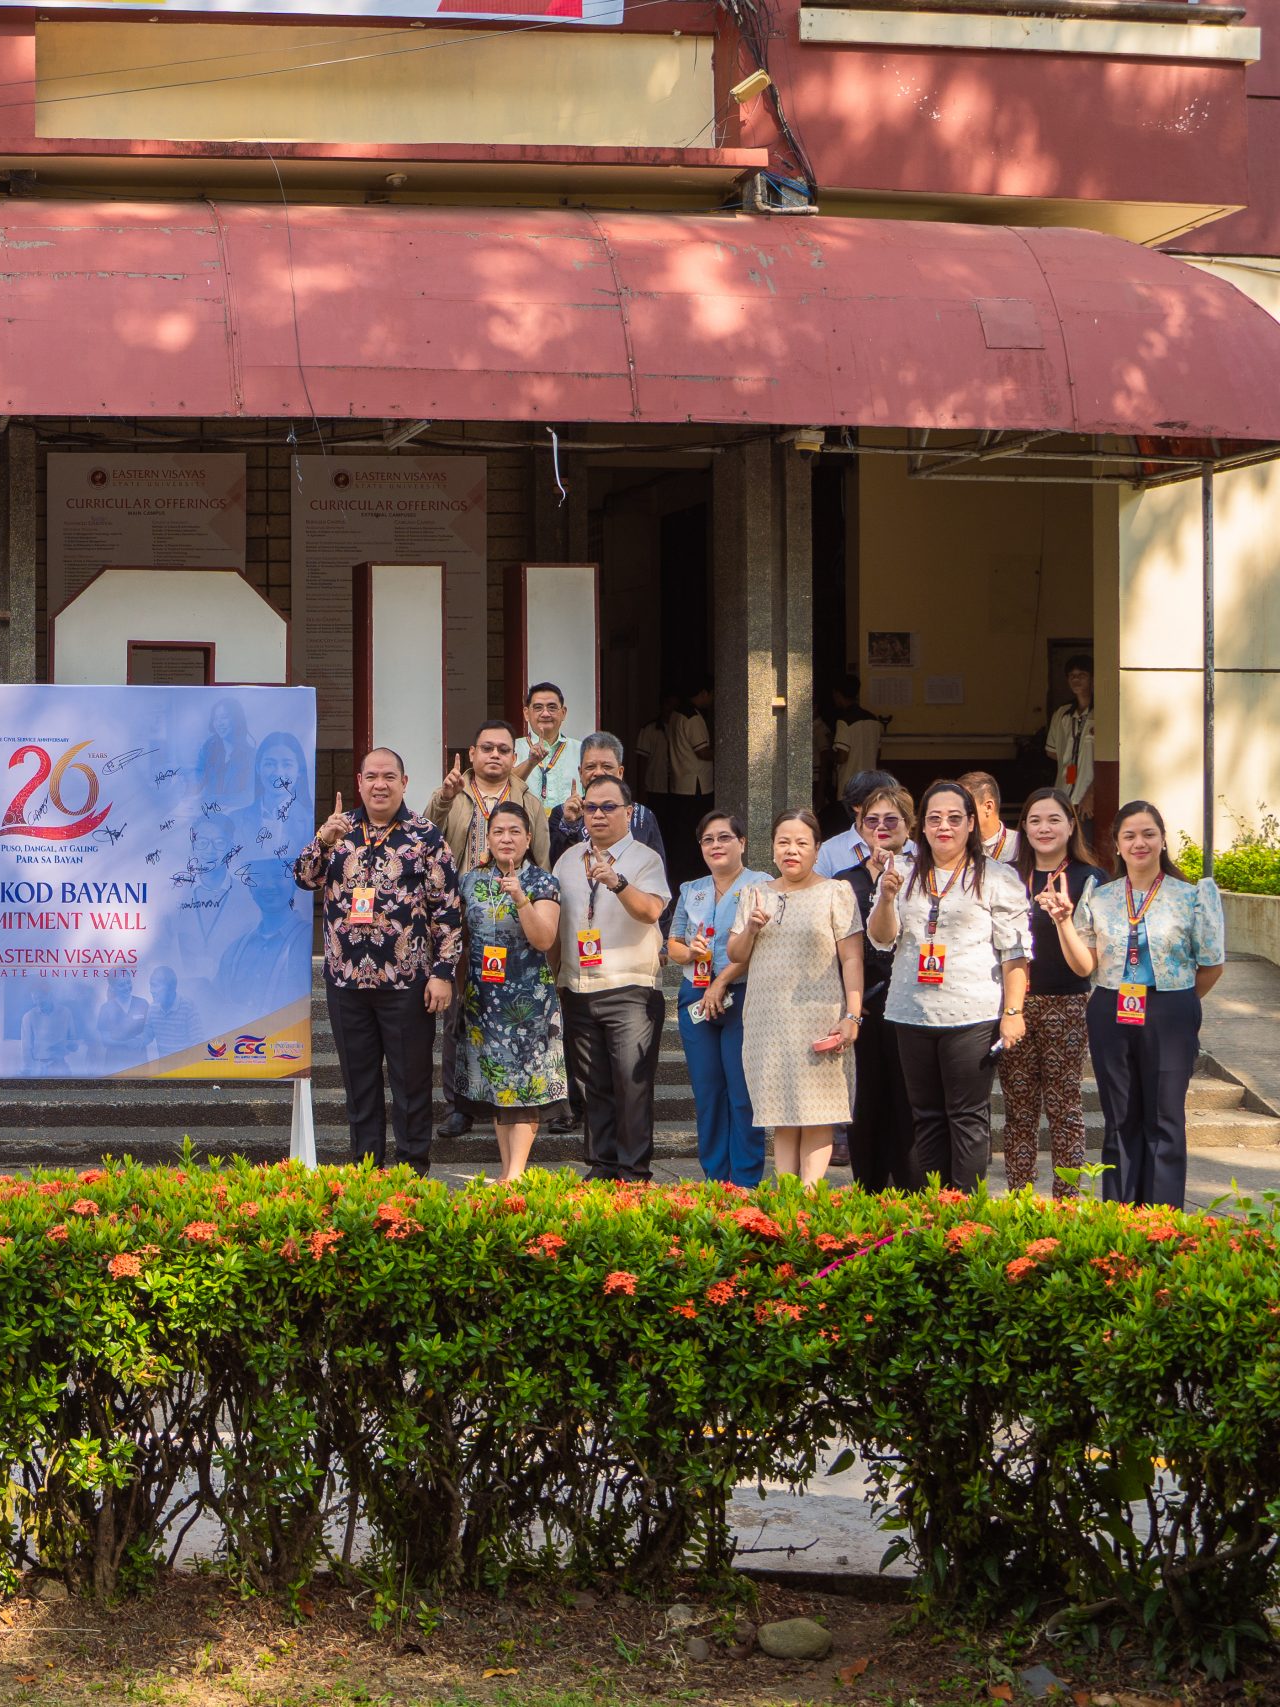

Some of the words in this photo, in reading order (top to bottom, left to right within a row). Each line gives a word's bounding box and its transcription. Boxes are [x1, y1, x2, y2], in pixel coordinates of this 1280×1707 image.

[112, 469, 159, 479] EASTERN
[163, 469, 206, 479] VISAYAS
[355, 471, 401, 481] EASTERN
[404, 472, 447, 482] VISAYAS
[66, 498, 150, 510] CURRICULAR
[154, 498, 226, 510] OFFERINGS
[310, 500, 392, 511] CURRICULAR
[397, 500, 468, 512] OFFERINGS
[24, 845, 57, 853] DANGAL,
[16, 855, 40, 864] PARA
[54, 856, 83, 864] BAYAN
[61, 882, 148, 904] BAYANI
[90, 912, 146, 930] WALL
[65, 949, 138, 964] VISAYAS
[40, 969, 138, 978] UNIVERSITY
[234, 1043, 266, 1054] CSC
